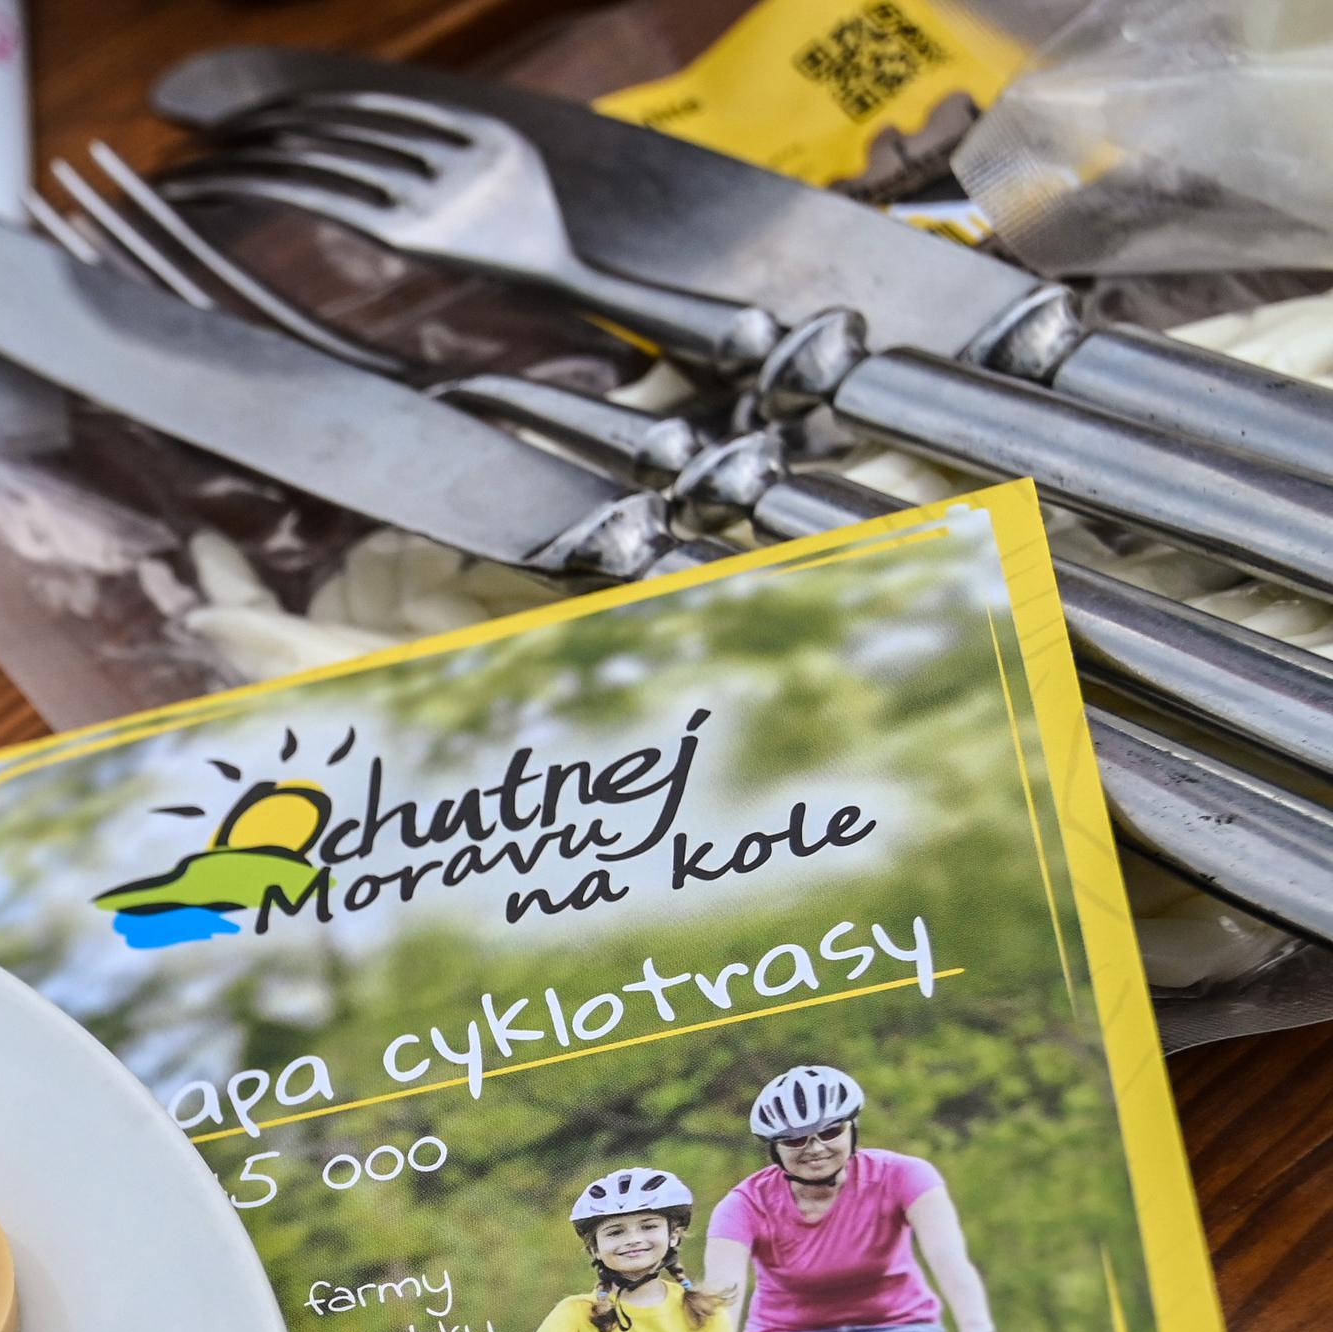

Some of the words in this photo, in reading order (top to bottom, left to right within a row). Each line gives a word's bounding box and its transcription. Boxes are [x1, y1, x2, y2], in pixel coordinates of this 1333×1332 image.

[213, 708, 711, 860] Ochutnej
[256, 816, 621, 934] Moravu
[504, 868, 631, 923] na
[670, 800, 877, 890] kole
[168, 1055, 334, 1138] apa
[383, 914, 937, 1099] cyklotrasy
[304, 1270, 453, 1317] farmy
